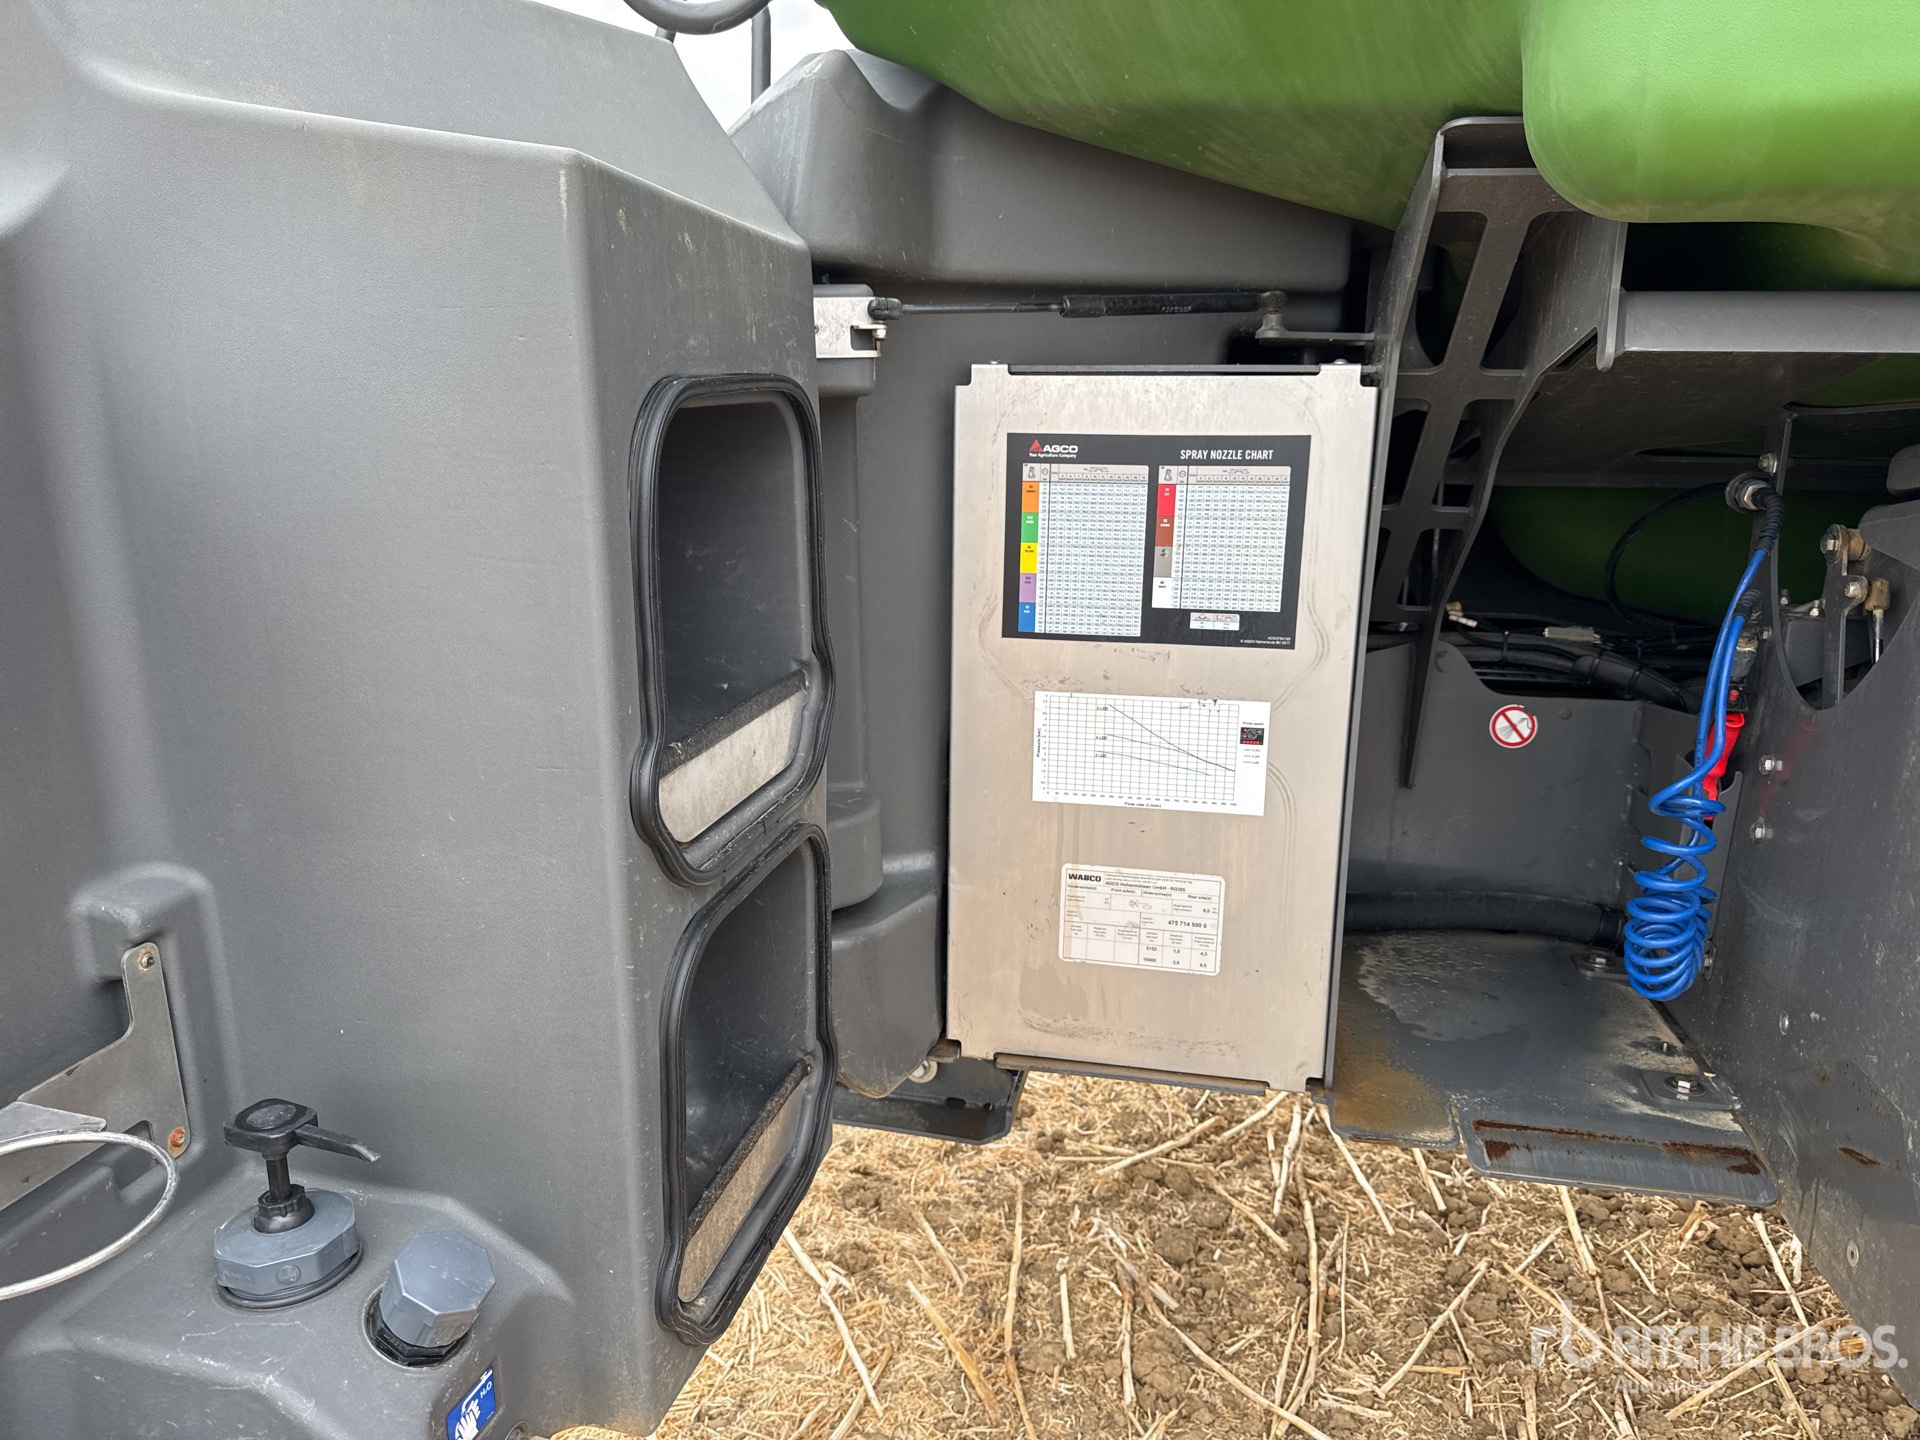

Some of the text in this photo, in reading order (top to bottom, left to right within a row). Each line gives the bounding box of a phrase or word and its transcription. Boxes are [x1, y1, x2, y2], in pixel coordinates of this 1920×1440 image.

[1043, 445, 1078, 453] AGCO
[1180, 450, 1273, 460] SPRAY NOZZLE CHART
[1068, 873, 1101, 882] WABCO
